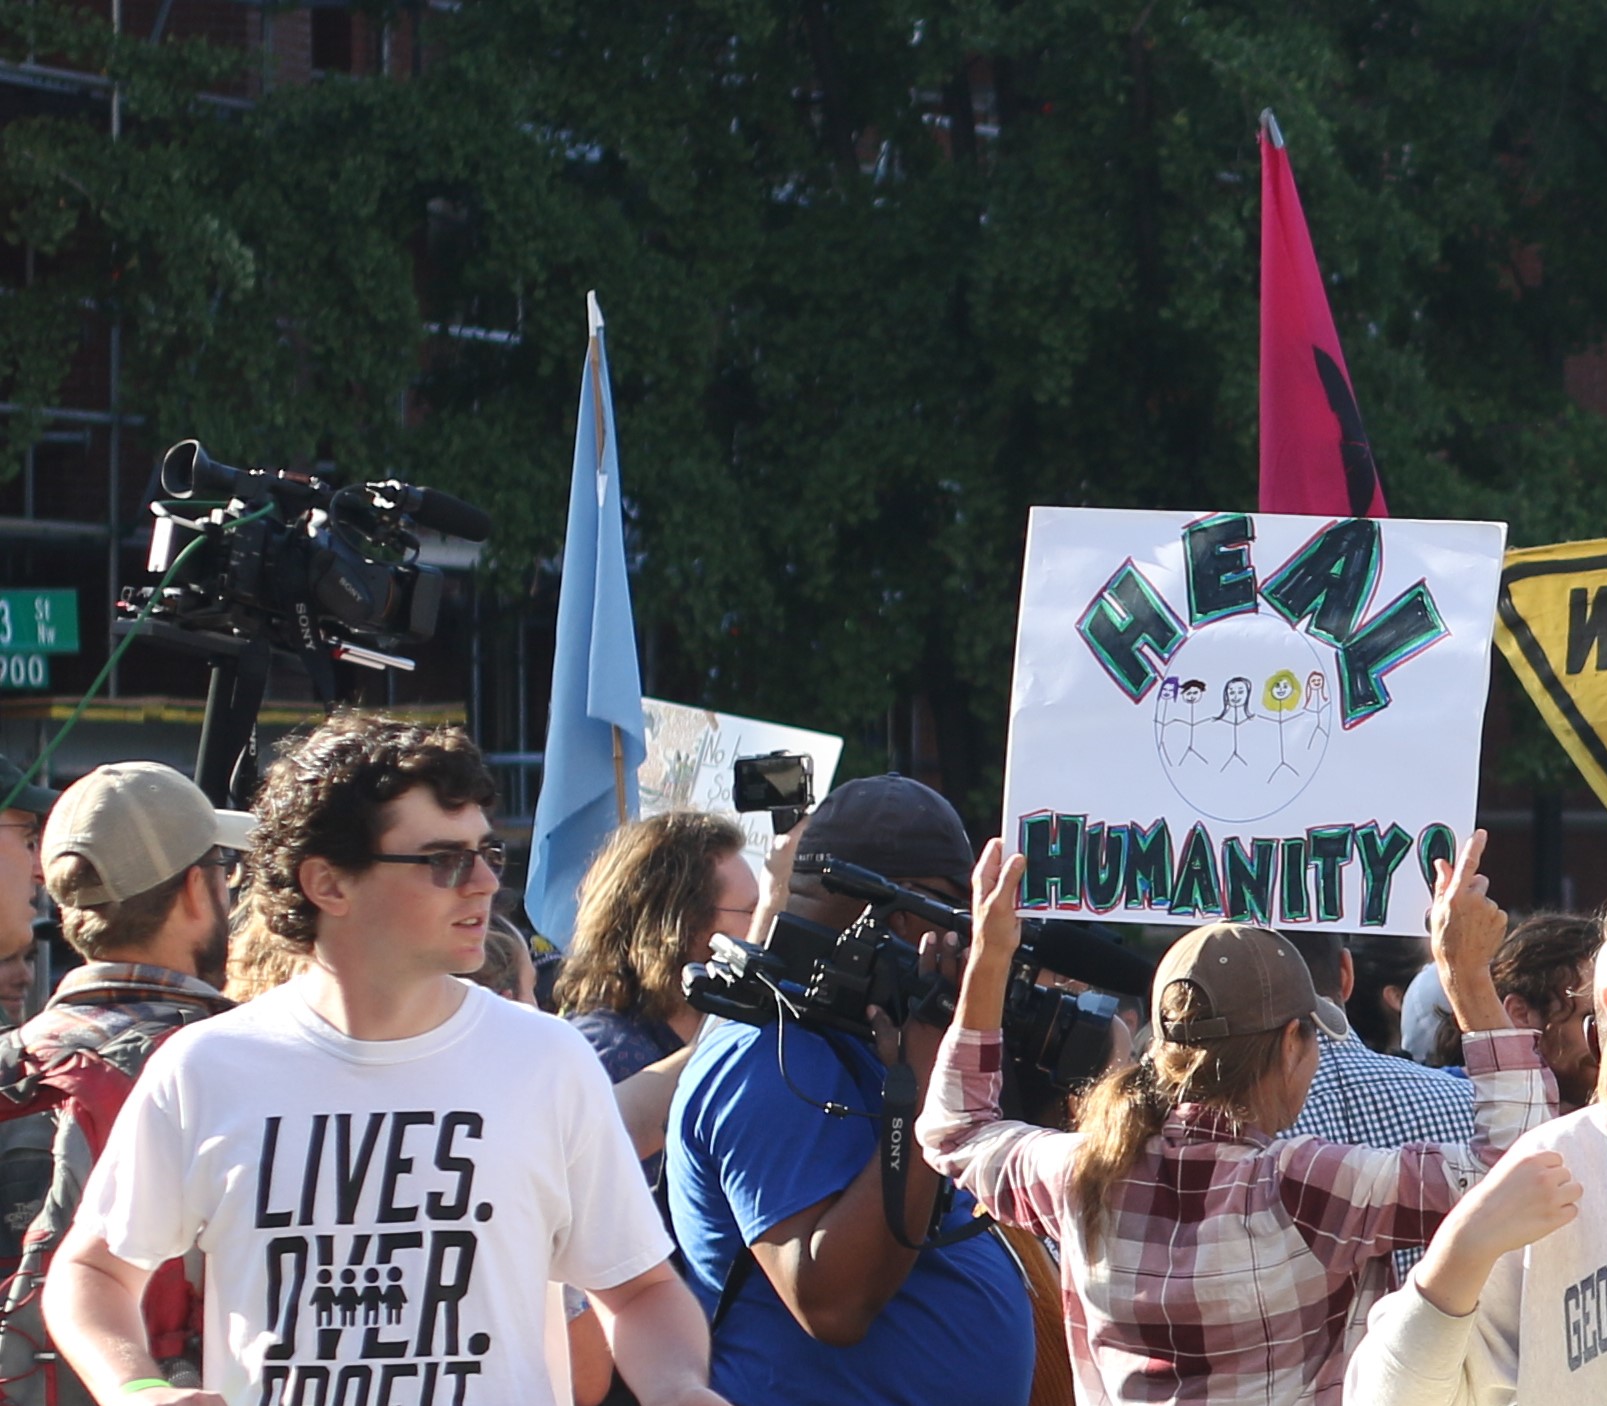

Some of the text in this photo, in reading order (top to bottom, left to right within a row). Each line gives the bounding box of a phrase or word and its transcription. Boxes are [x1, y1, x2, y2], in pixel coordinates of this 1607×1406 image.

[338, 576, 363, 602] SONY
[296, 602, 316, 650] SONY
[1075, 512, 1452, 730] HEAL
[255, 1110, 495, 1230] LIVES.
[890, 1117, 904, 1171] SONY
